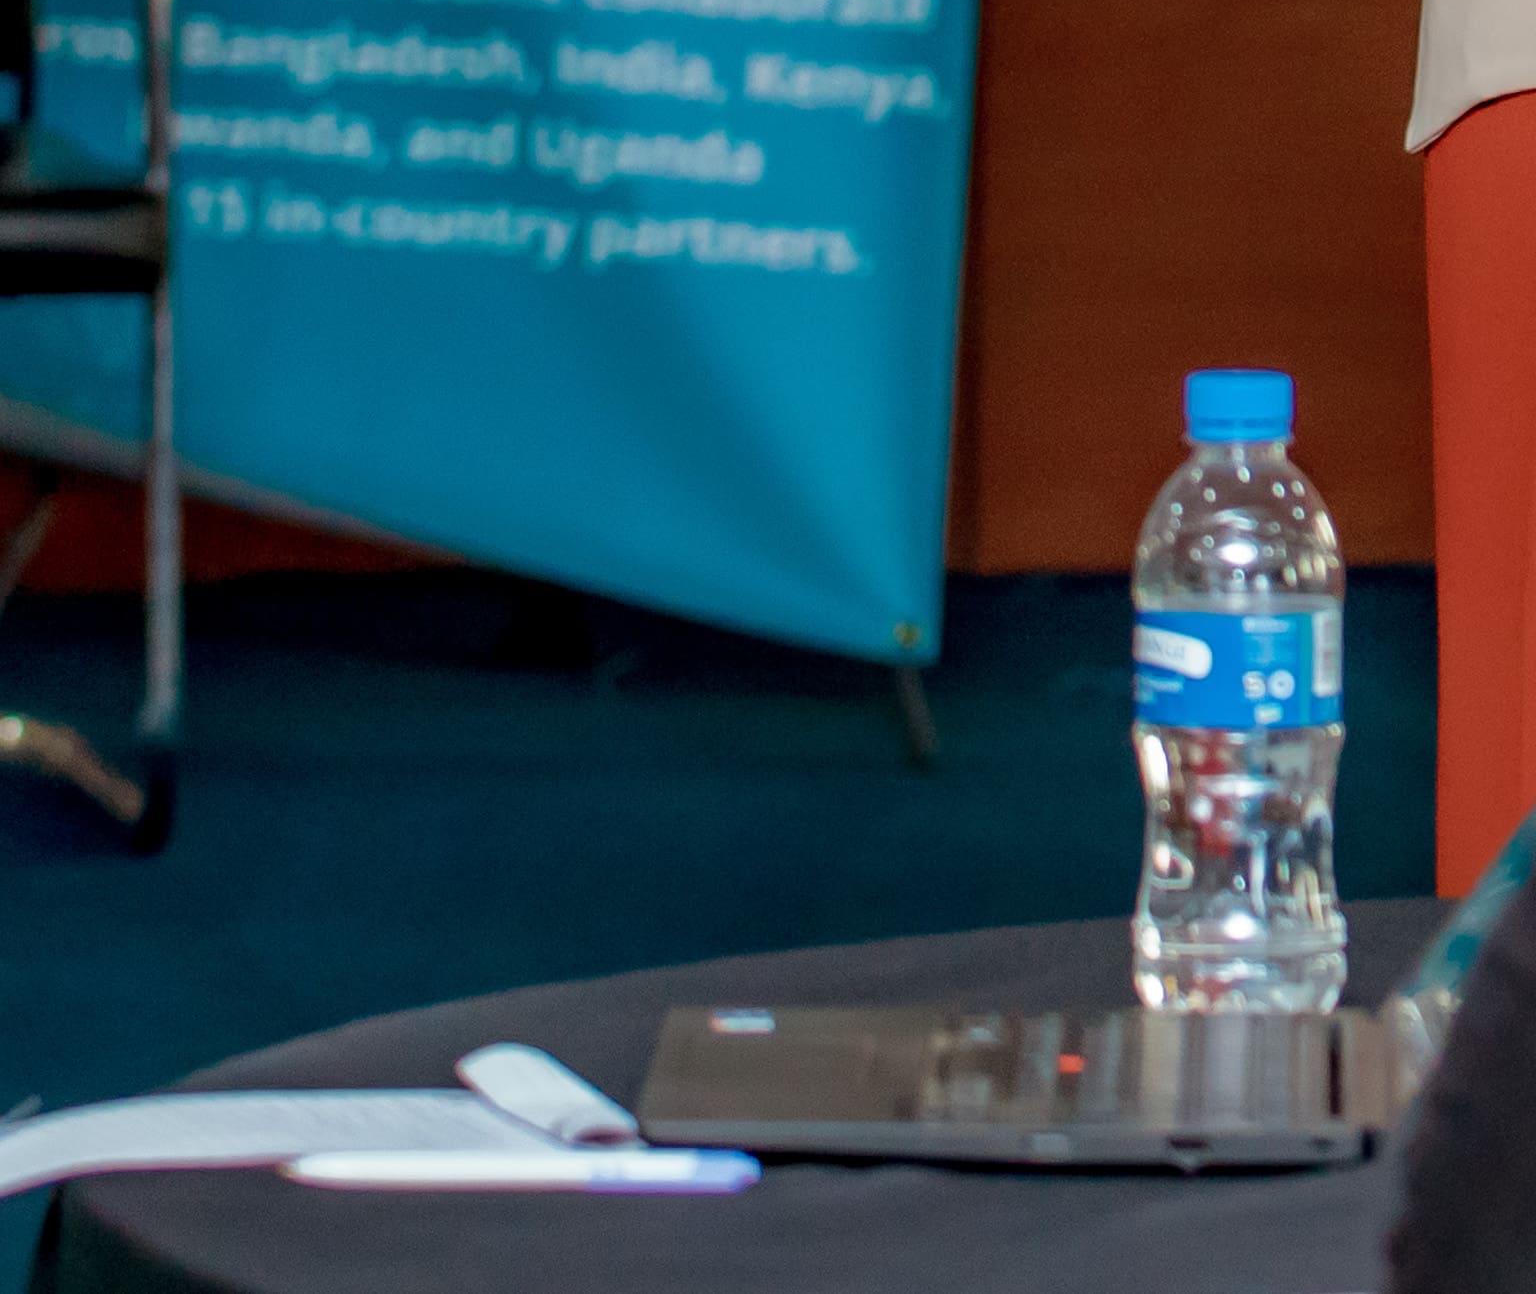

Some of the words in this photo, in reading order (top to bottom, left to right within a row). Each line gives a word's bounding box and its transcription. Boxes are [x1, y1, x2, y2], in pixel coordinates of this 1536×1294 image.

[179, 19, 536, 87] Bangladesh,
[556, 39, 725, 102] India,
[164, 107, 389, 167] wanda,
[405, 121, 517, 168] and
[534, 129, 767, 187] Uganda
